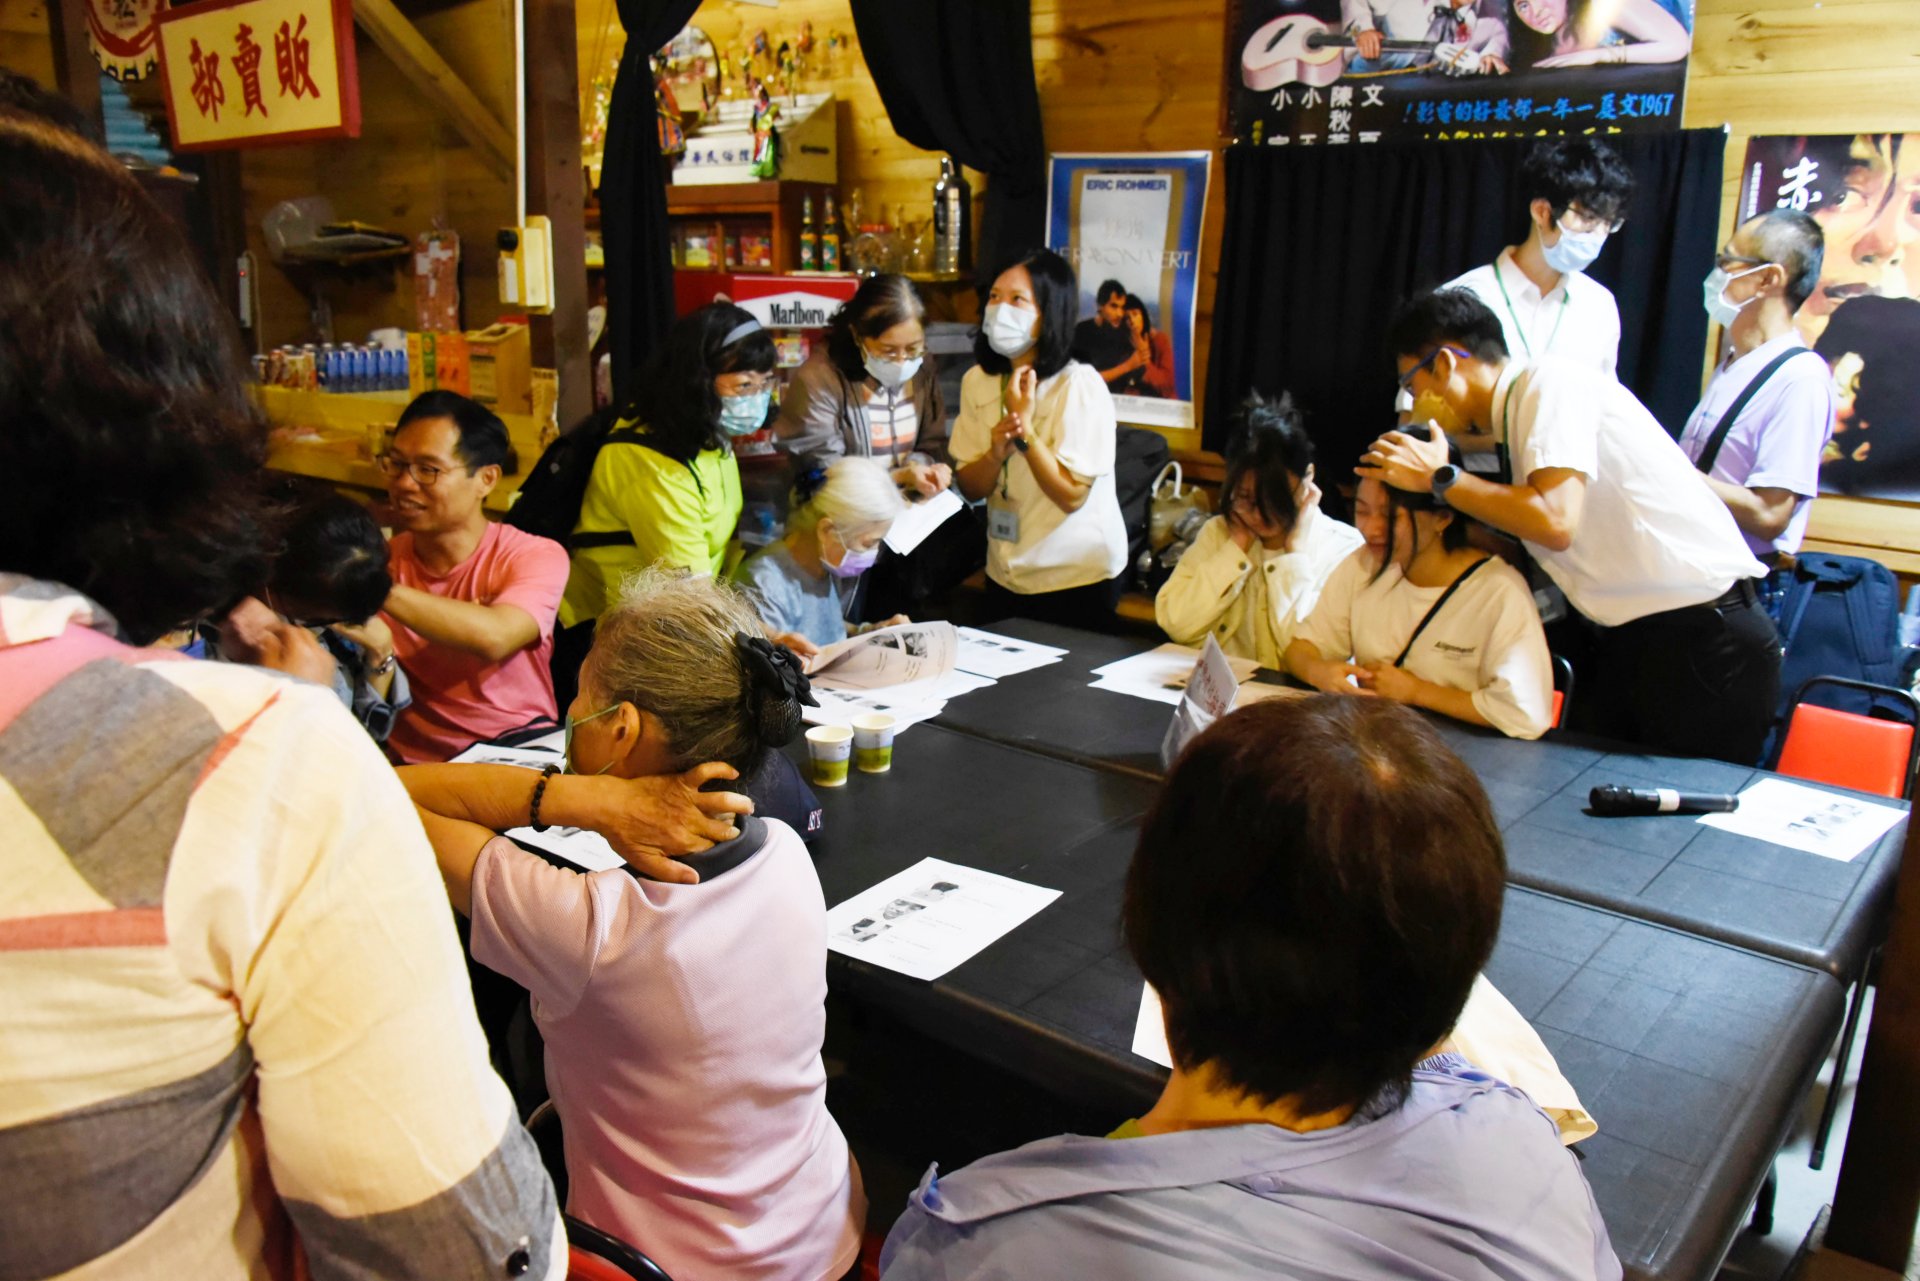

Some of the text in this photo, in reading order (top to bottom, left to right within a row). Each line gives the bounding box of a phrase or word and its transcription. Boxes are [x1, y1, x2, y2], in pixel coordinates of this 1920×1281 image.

[1086, 179, 1167, 191] ERIC ROHMER
[770, 301, 825, 325] Marlboro
